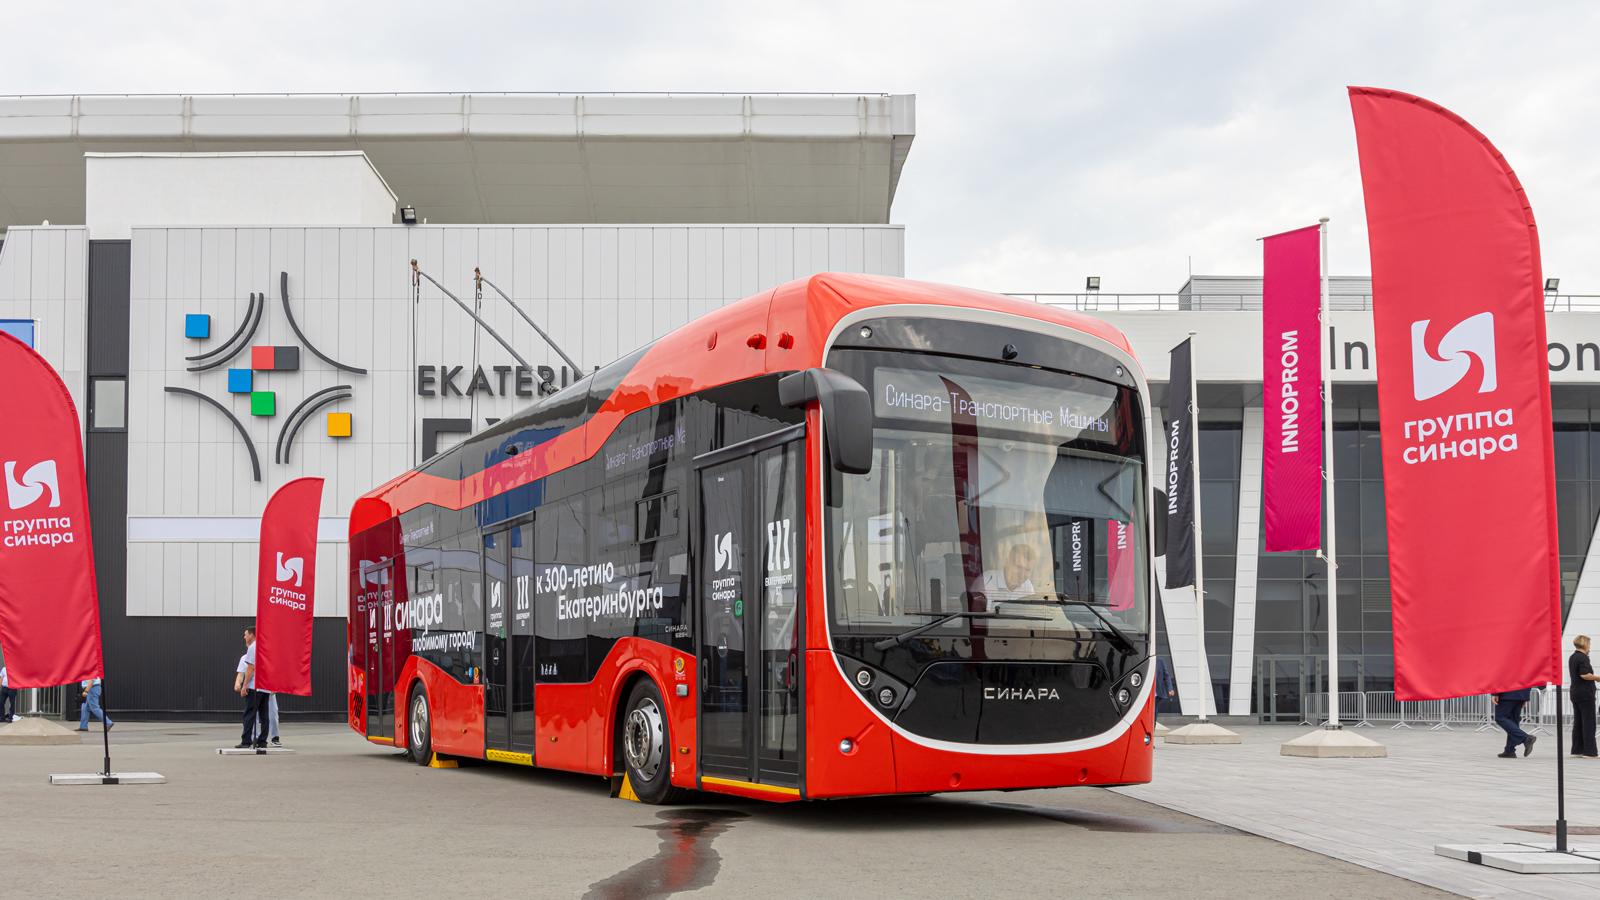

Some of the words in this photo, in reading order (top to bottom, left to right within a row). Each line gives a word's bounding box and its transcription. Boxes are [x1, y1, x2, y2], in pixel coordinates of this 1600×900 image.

[1281, 330, 1299, 453] INNOPROM
[885, 384, 1053, 426] Синара-Транспортные
[1059, 406, 1109, 433] Машины
[1404, 408, 1514, 442] группа
[1402, 433, 1518, 465] синара
[1168, 419, 1180, 515] INNOPROM
[3, 516, 71, 534] группа
[3, 532, 74, 548] синара
[536, 575, 543, 595] к
[544, 561, 614, 594] 300-летию
[712, 577, 735, 591] группа
[269, 596, 306, 611] синара
[270, 586, 306, 601] группа
[558, 582, 663, 623] Екатеринбурга
[712, 589, 735, 601] синара
[394, 593, 443, 634] синара
[664, 624, 688, 633] СИНАРА
[412, 631, 448, 653] любимому
[449, 630, 476, 650] городу
[983, 687, 1061, 701] СИНАРА
